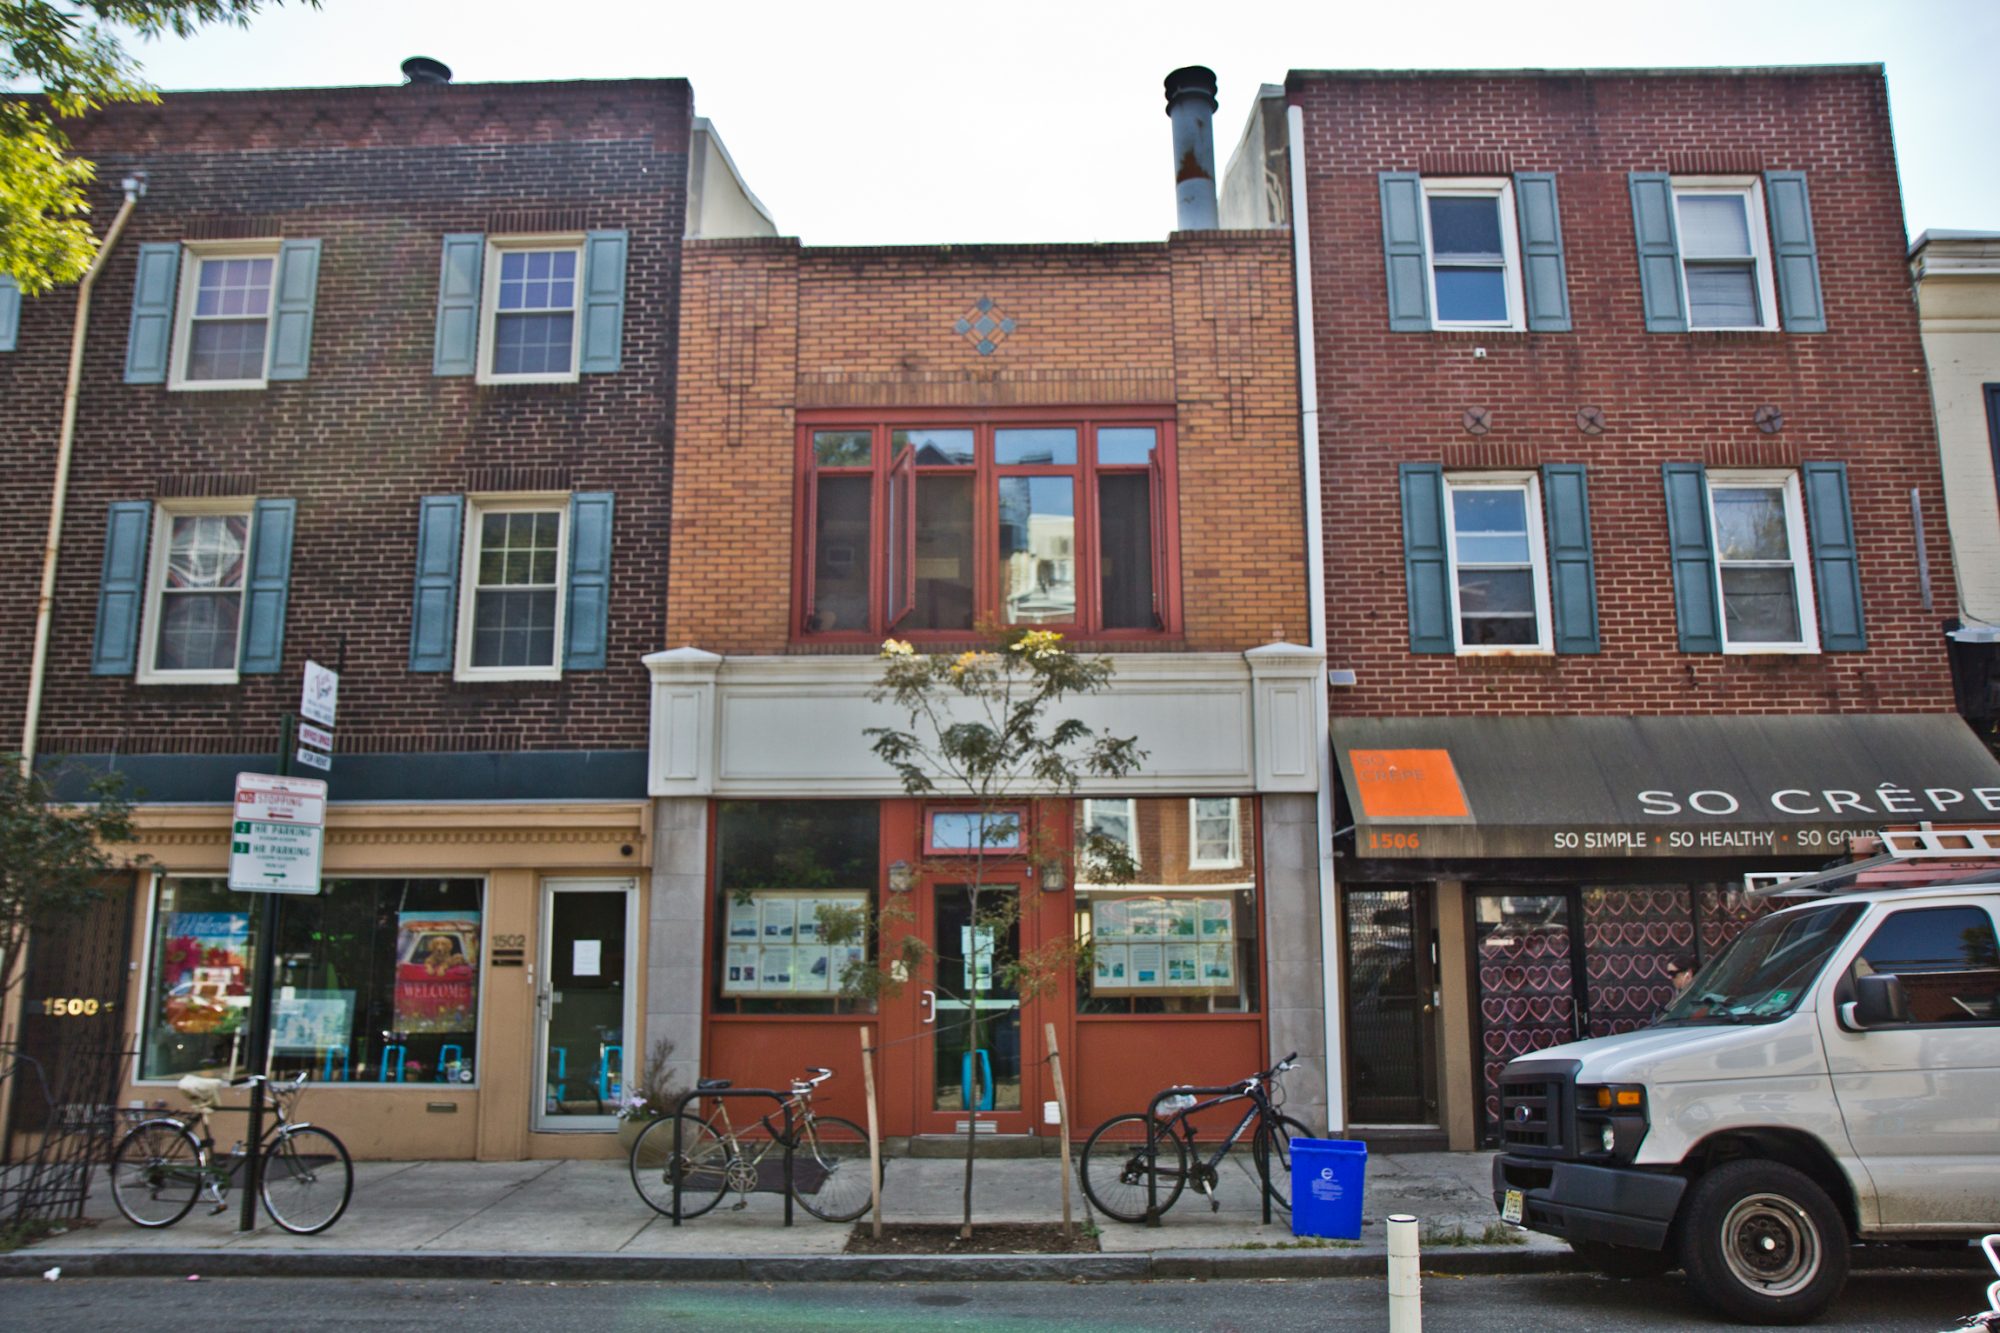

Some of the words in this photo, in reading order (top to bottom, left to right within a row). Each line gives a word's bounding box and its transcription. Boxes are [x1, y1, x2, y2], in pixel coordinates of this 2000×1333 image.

[1358, 754, 1385, 767] SO
[257, 792, 303, 807] STOPPING
[1637, 789, 1740, 815] SO
[254, 823, 268, 833] HR
[271, 825, 312, 837] PARKING
[1369, 833, 1420, 849] 1506
[1554, 832, 1579, 848] SO
[1584, 832, 1647, 848] SIMPLE
[1669, 832, 1694, 847] SO
[1700, 831, 1775, 846] HEALTHY
[1797, 830, 1822, 846] SO
[252, 844, 266, 853] HR
[270, 844, 312, 857] PARKING
[493, 934, 526, 948] 1502
[403, 983, 468, 999] WELCOME
[42, 997, 99, 1016] 1500
